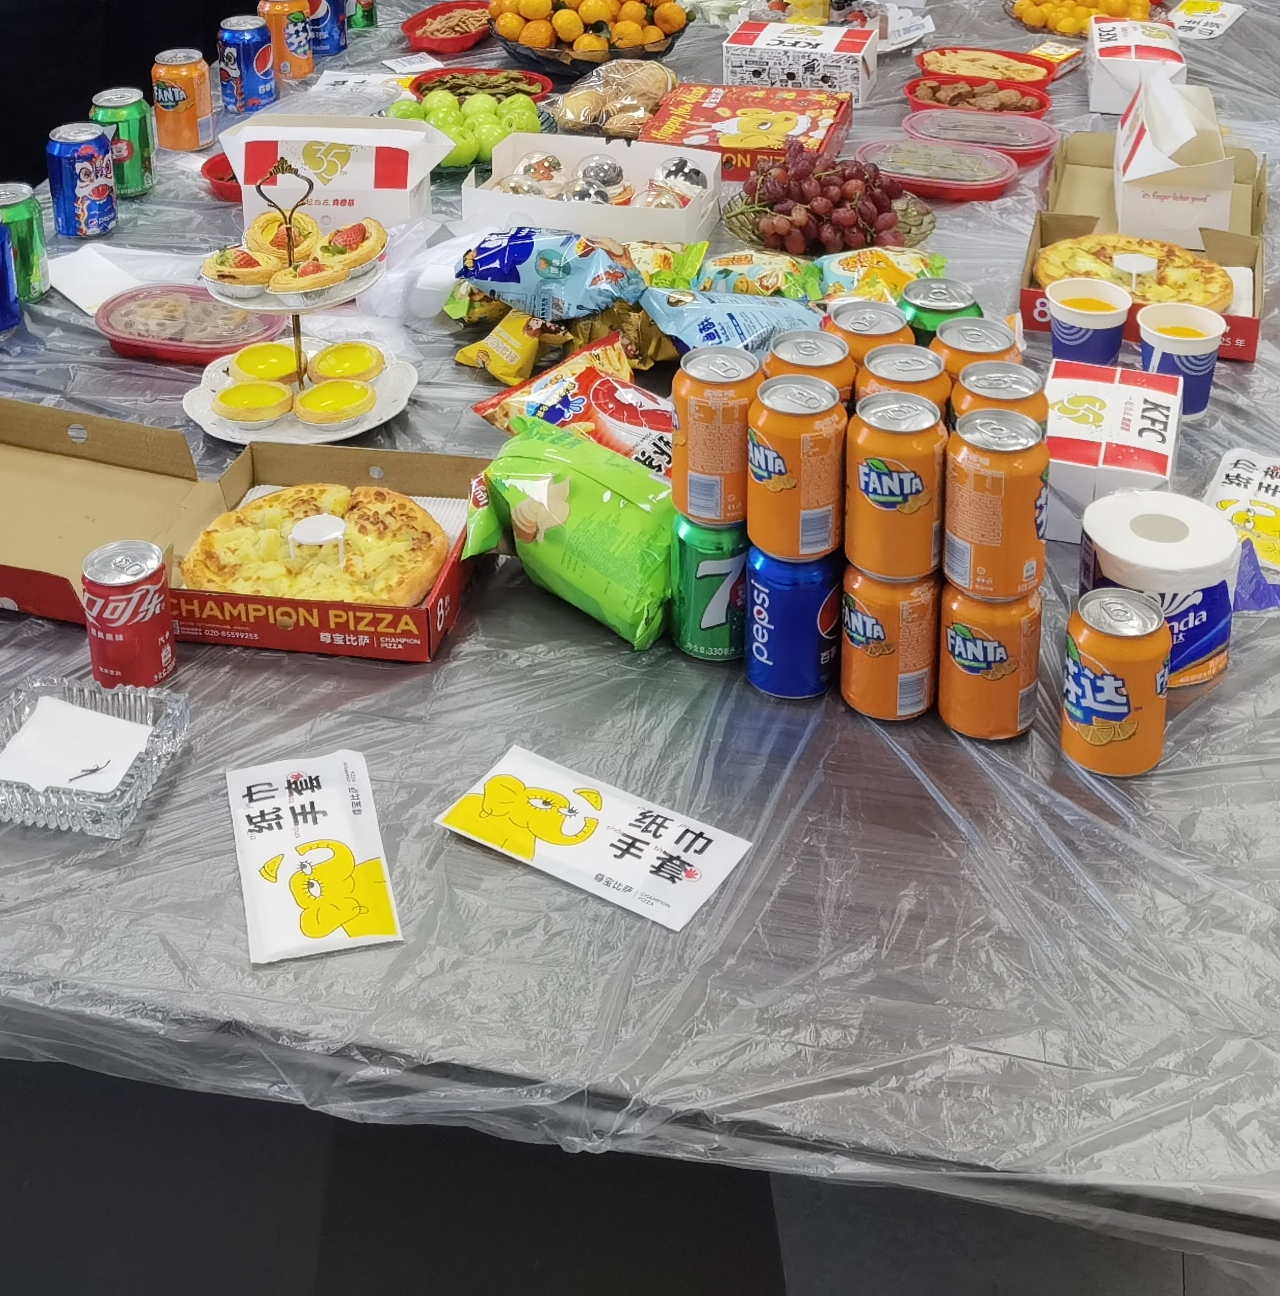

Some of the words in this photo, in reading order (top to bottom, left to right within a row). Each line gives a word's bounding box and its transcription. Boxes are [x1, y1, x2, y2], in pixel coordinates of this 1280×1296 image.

[153, 83, 188, 102] FANTA
[311, 146, 345, 179] 35
[1137, 398, 1171, 444] KFC
[858, 465, 924, 496] FANTA
[84, 584, 164, 628] 口可乐
[328, 610, 419, 634] PIZZA
[752, 580, 774, 665] pepsi
[319, 632, 370, 646] 尊宝比萨
[380, 637, 420, 645] CHAMPION
[947, 632, 1008, 663] FANTA
[242, 782, 283, 834] 纸巾
[285, 774, 328, 825] 手套
[628, 810, 714, 856] 纸巾
[609, 834, 693, 884] 手套
[594, 872, 634, 893] 尊宝比萨
